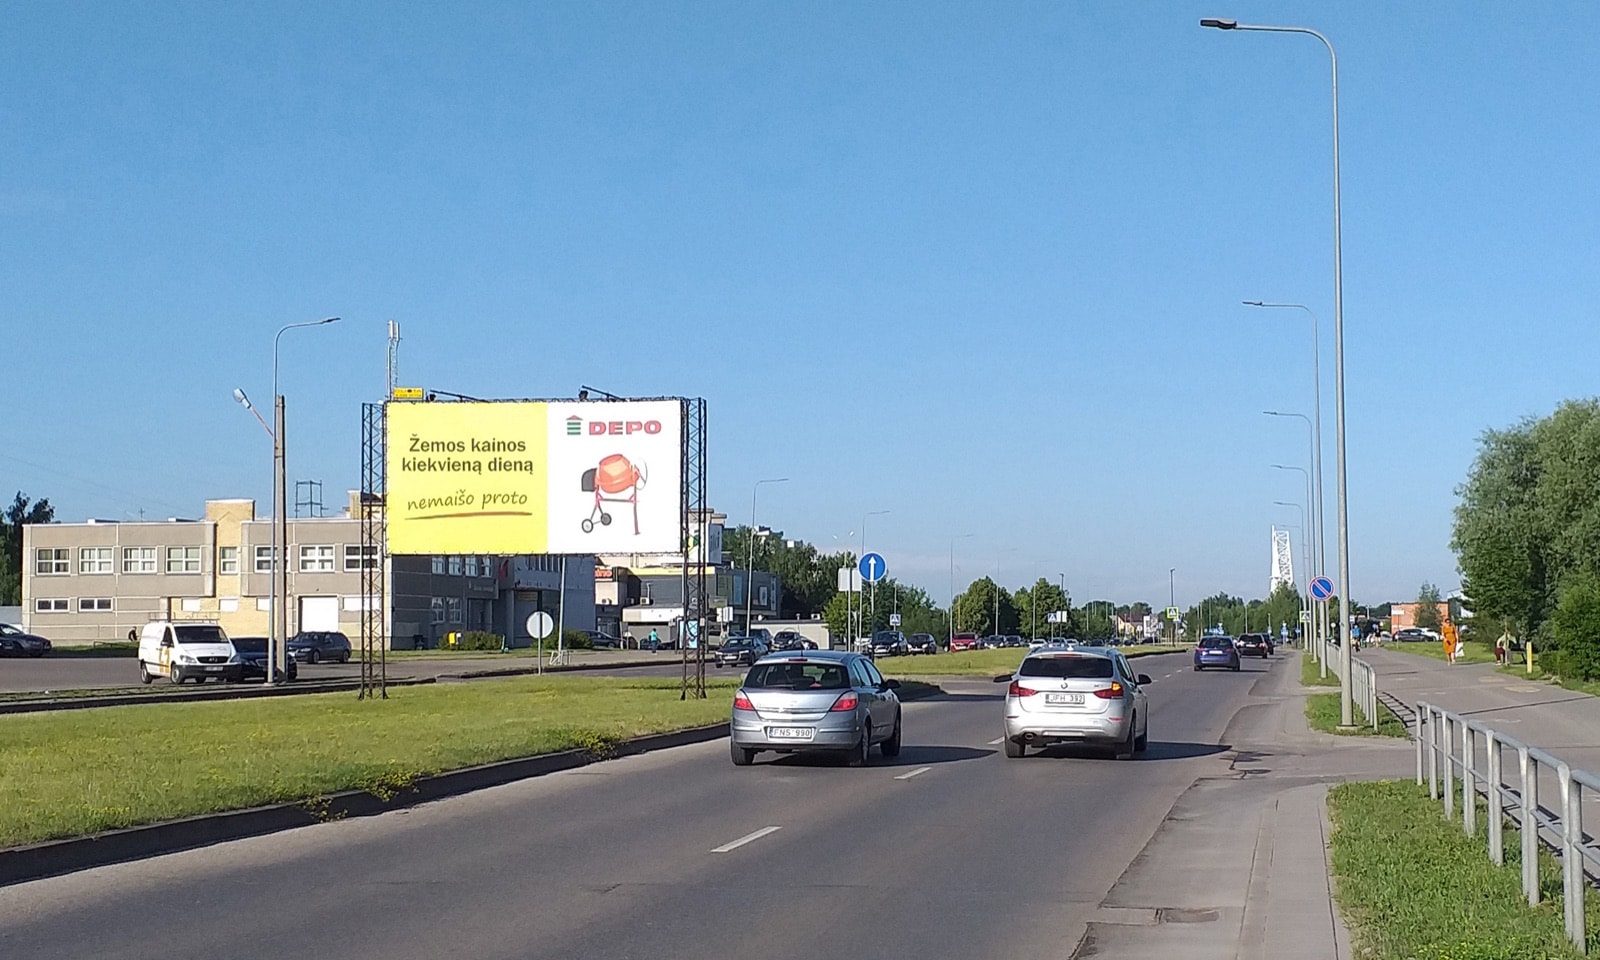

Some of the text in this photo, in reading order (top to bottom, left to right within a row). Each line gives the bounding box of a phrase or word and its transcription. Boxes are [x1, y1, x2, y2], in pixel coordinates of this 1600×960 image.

[588, 420, 662, 436] DEPO
[409, 434, 526, 453] Žemos kainos
[402, 456, 533, 475] kiekvieną dieną
[407, 489, 528, 510] nemaišo proto
